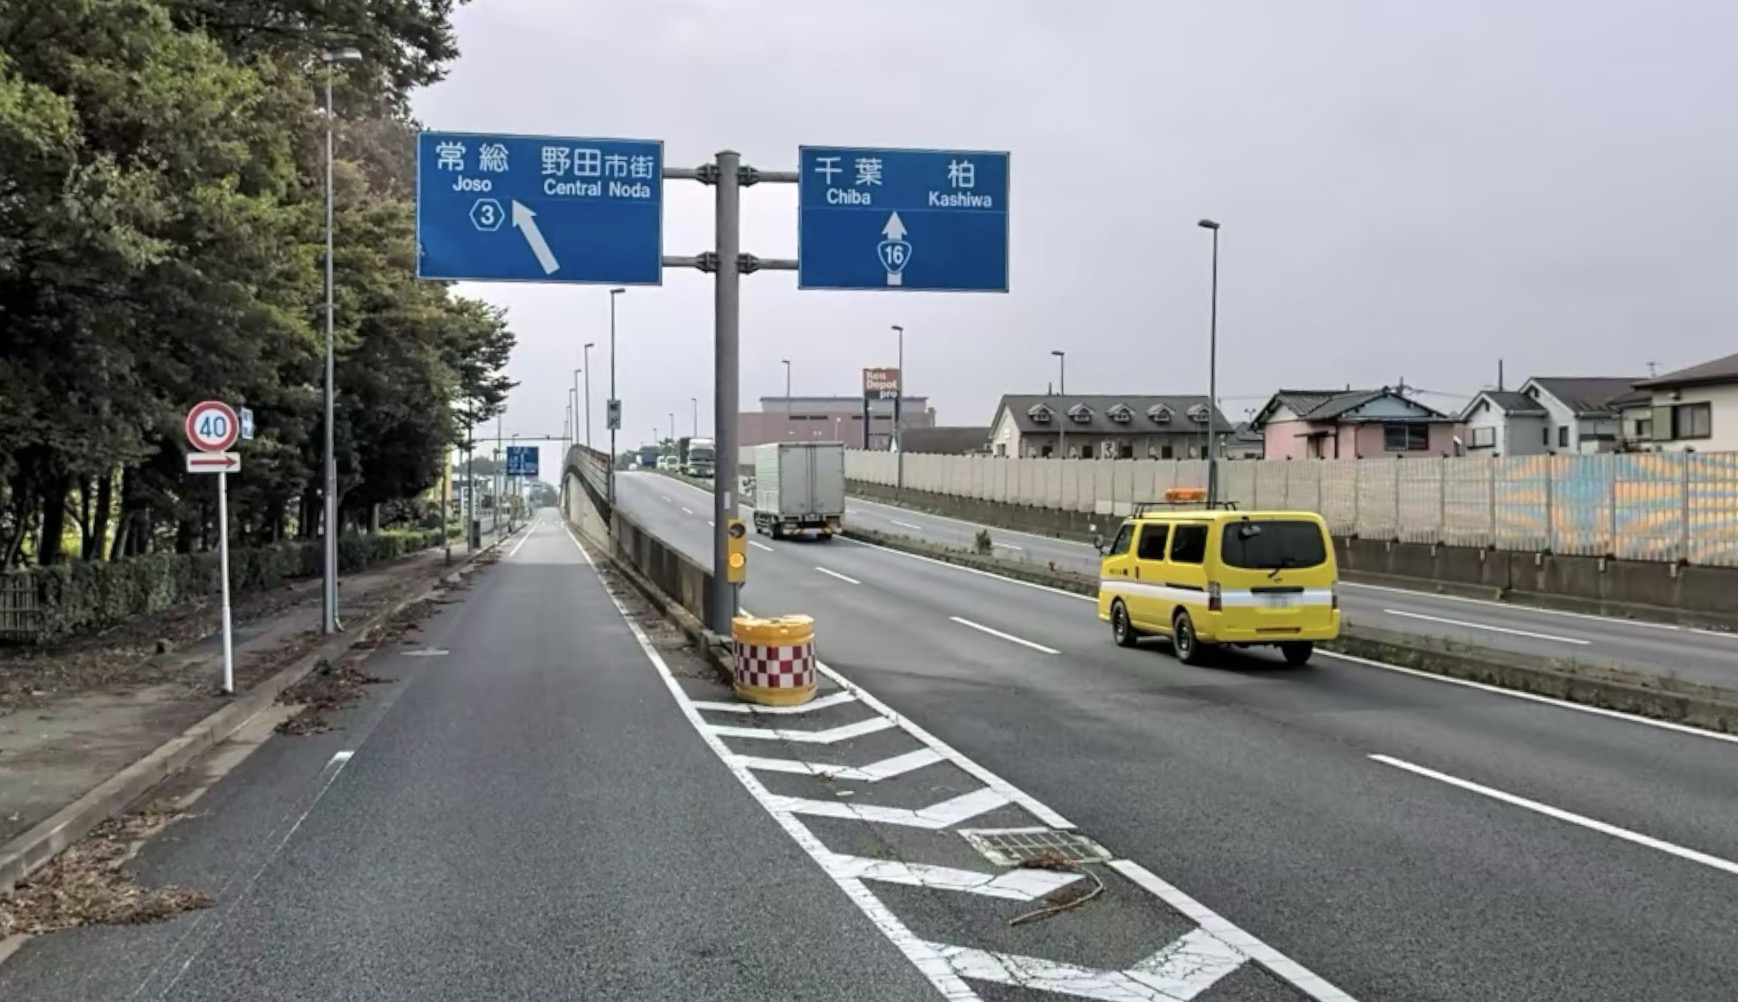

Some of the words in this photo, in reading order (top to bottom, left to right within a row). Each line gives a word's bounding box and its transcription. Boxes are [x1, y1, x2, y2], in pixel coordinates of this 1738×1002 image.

[541, 146, 654, 179] 野田市街
[815, 156, 882, 186] 千葉
[947, 159, 975, 188] 柏
[453, 175, 492, 192] Joso
[543, 179, 601, 197] Central
[609, 181, 650, 198] Noda
[826, 188, 871, 205] Chiba
[928, 191, 992, 208] Kashiwa
[480, 205, 494, 225] 3
[885, 246, 904, 264] 16
[867, 380, 897, 390] Depot
[880, 390, 898, 399] pro
[200, 416, 226, 438] 40
